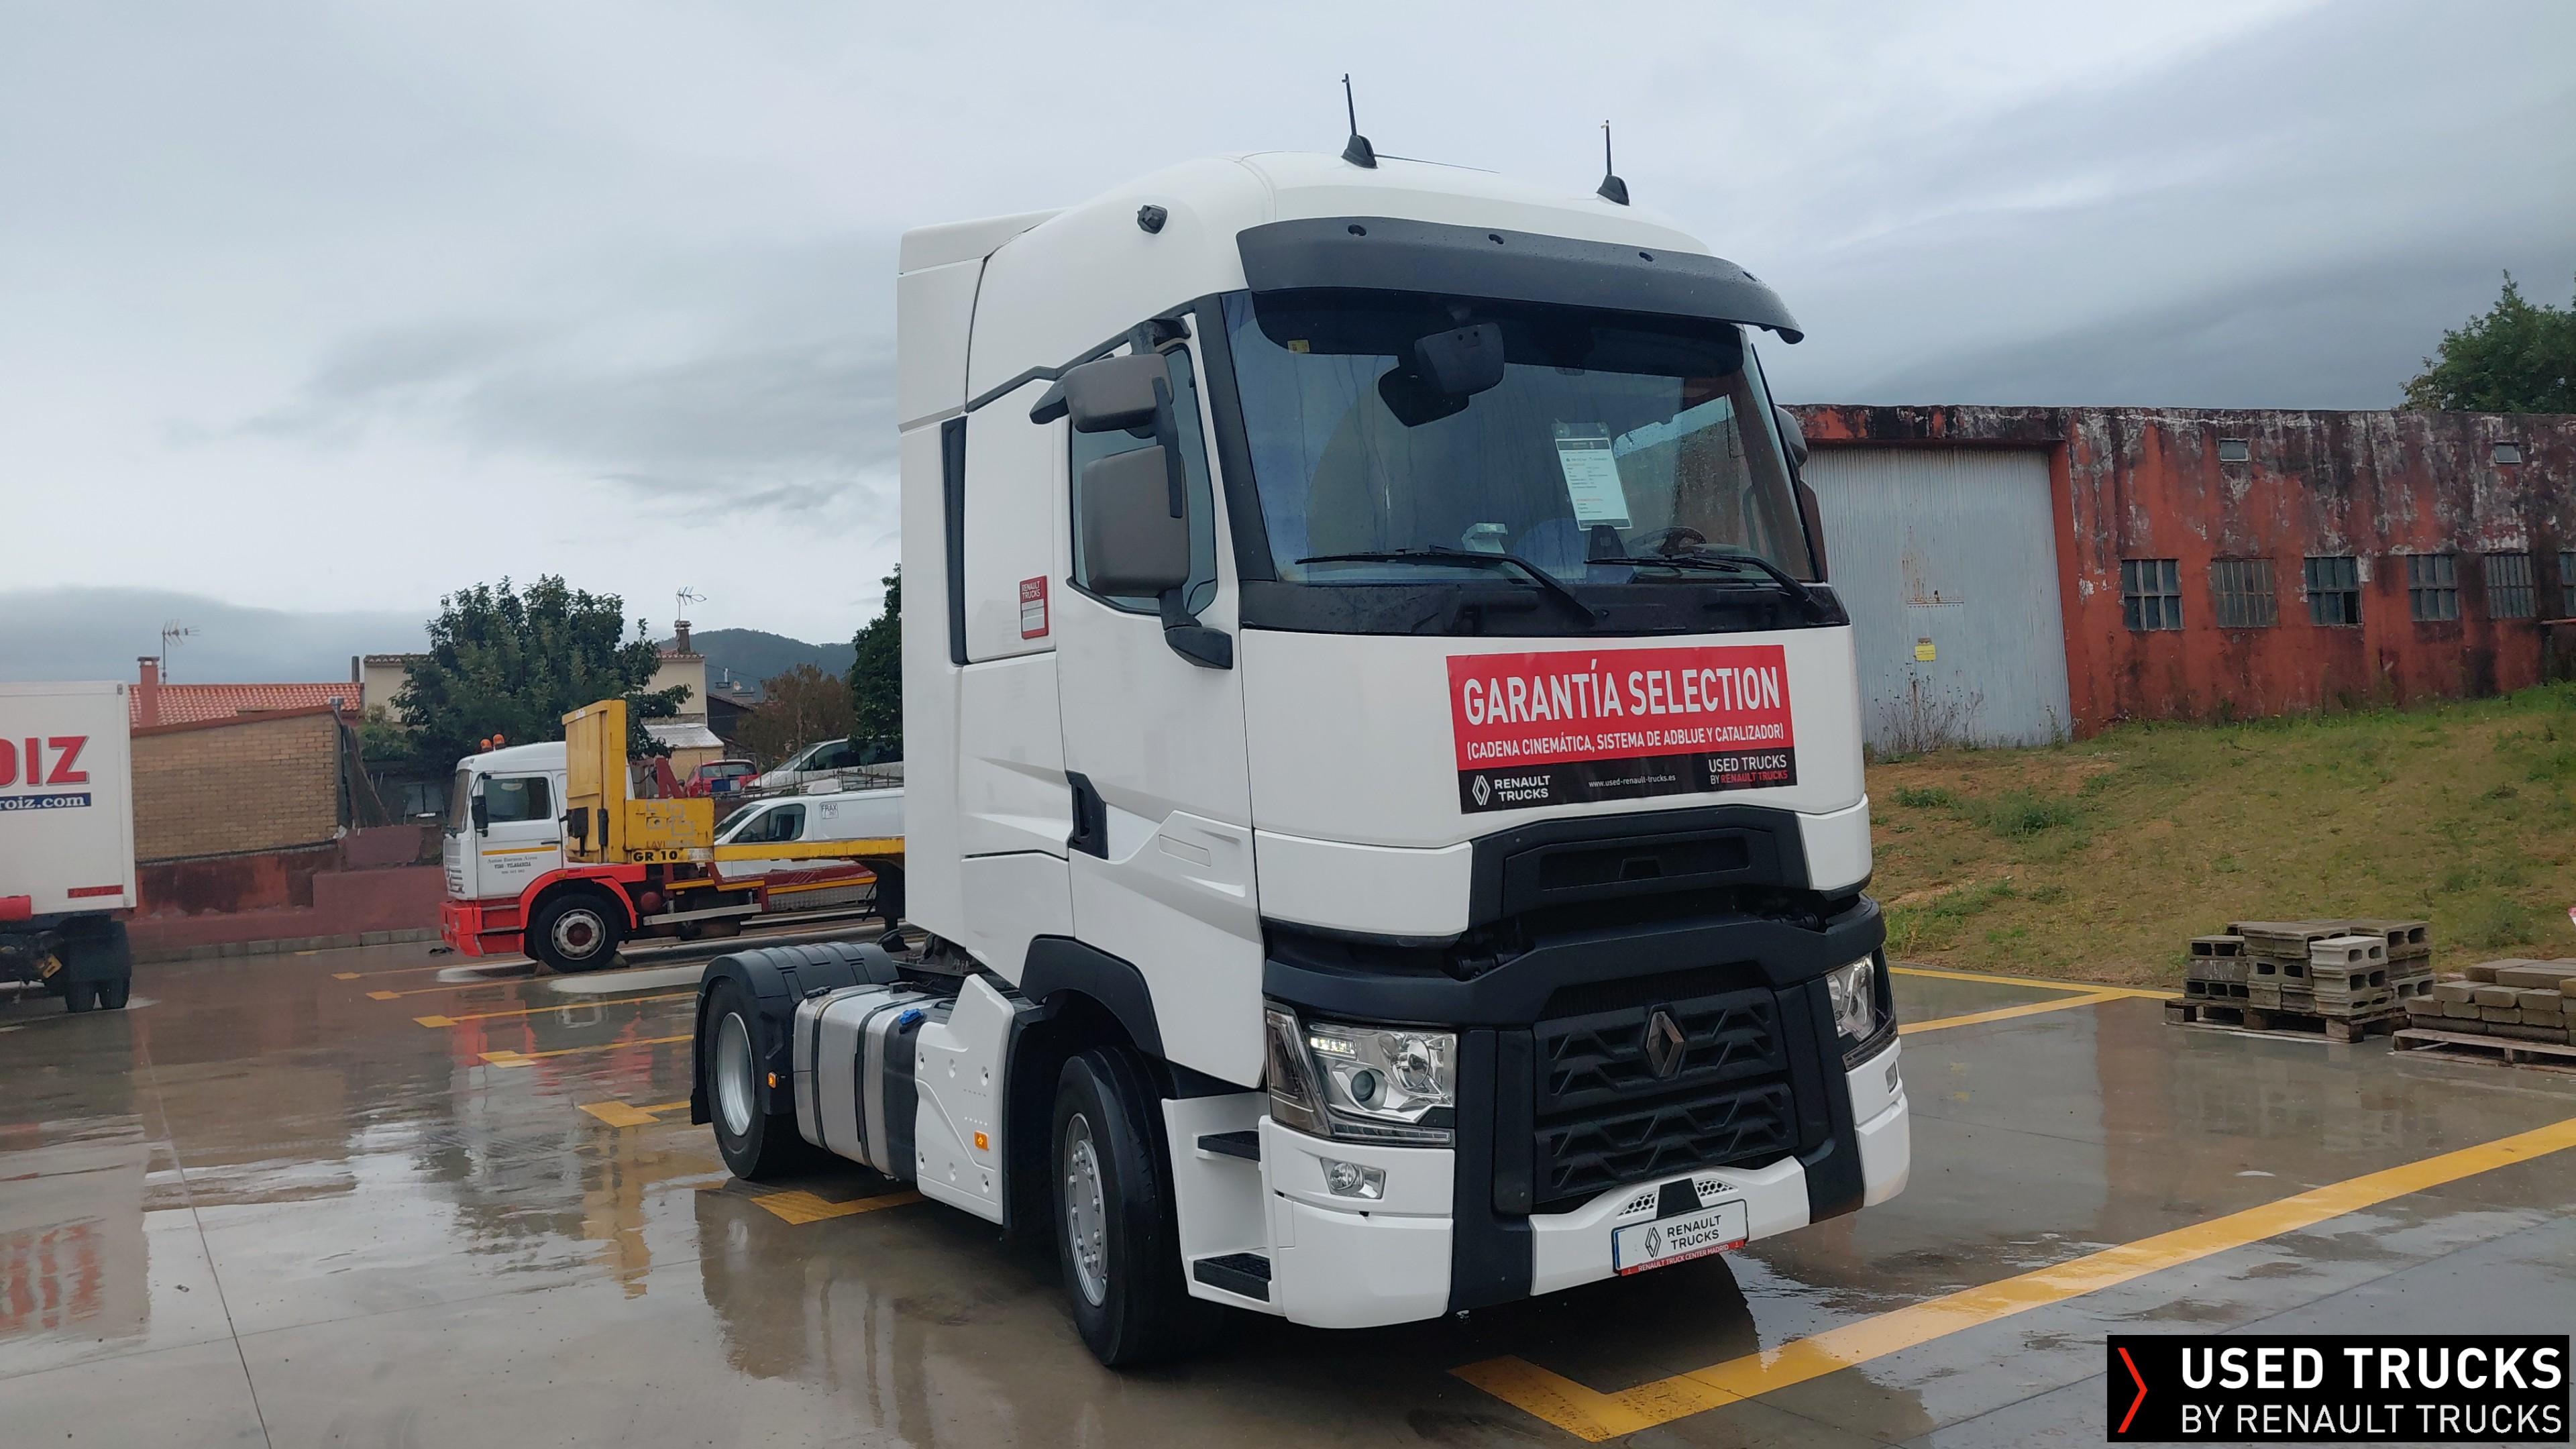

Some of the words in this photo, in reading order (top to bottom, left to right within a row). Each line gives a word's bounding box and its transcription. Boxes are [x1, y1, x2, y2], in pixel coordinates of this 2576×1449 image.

[1022, 581, 1040, 591] RENAULT
[1022, 589, 1040, 600] TRUCKS
[1464, 659, 1623, 725] GARANTÍA
[1628, 667, 1781, 715] SELECTION
[1467, 740, 1520, 761] (CADENA
[1522, 731, 1595, 755] CINEMÁTICA,
[1597, 731, 1645, 750] SISTEMA
[1648, 731, 1662, 747] DE
[1664, 728, 1705, 745] ADBLUE
[1706, 727, 1713, 743] Y
[1715, 722, 1784, 742] CATALIZADOR)
[1708, 757, 1739, 772] USED
[1741, 754, 1787, 769] TRUCKS
[1494, 775, 1551, 790] RENAULT
[1589, 774, 1676, 788] www.used-renault-trucks.es
[1711, 774, 1720, 784] BY
[1721, 772, 1756, 784] RENAULT
[1758, 769, 1788, 780] TRUCKS
[1498, 788, 1549, 802] TRUCKS
[633, 851, 654, 861] GR
[661, 851, 678, 860] 10
[1667, 1215, 1722, 1238] RENAULT
[1670, 1229, 1719, 1250] TRUCKS
[1638, 1259, 1665, 1272] RENAULT
[1666, 1256, 1684, 1266] TRUCK
[1685, 1250, 1707, 1262] CENTER
[1707, 1244, 1729, 1256] MADRID
